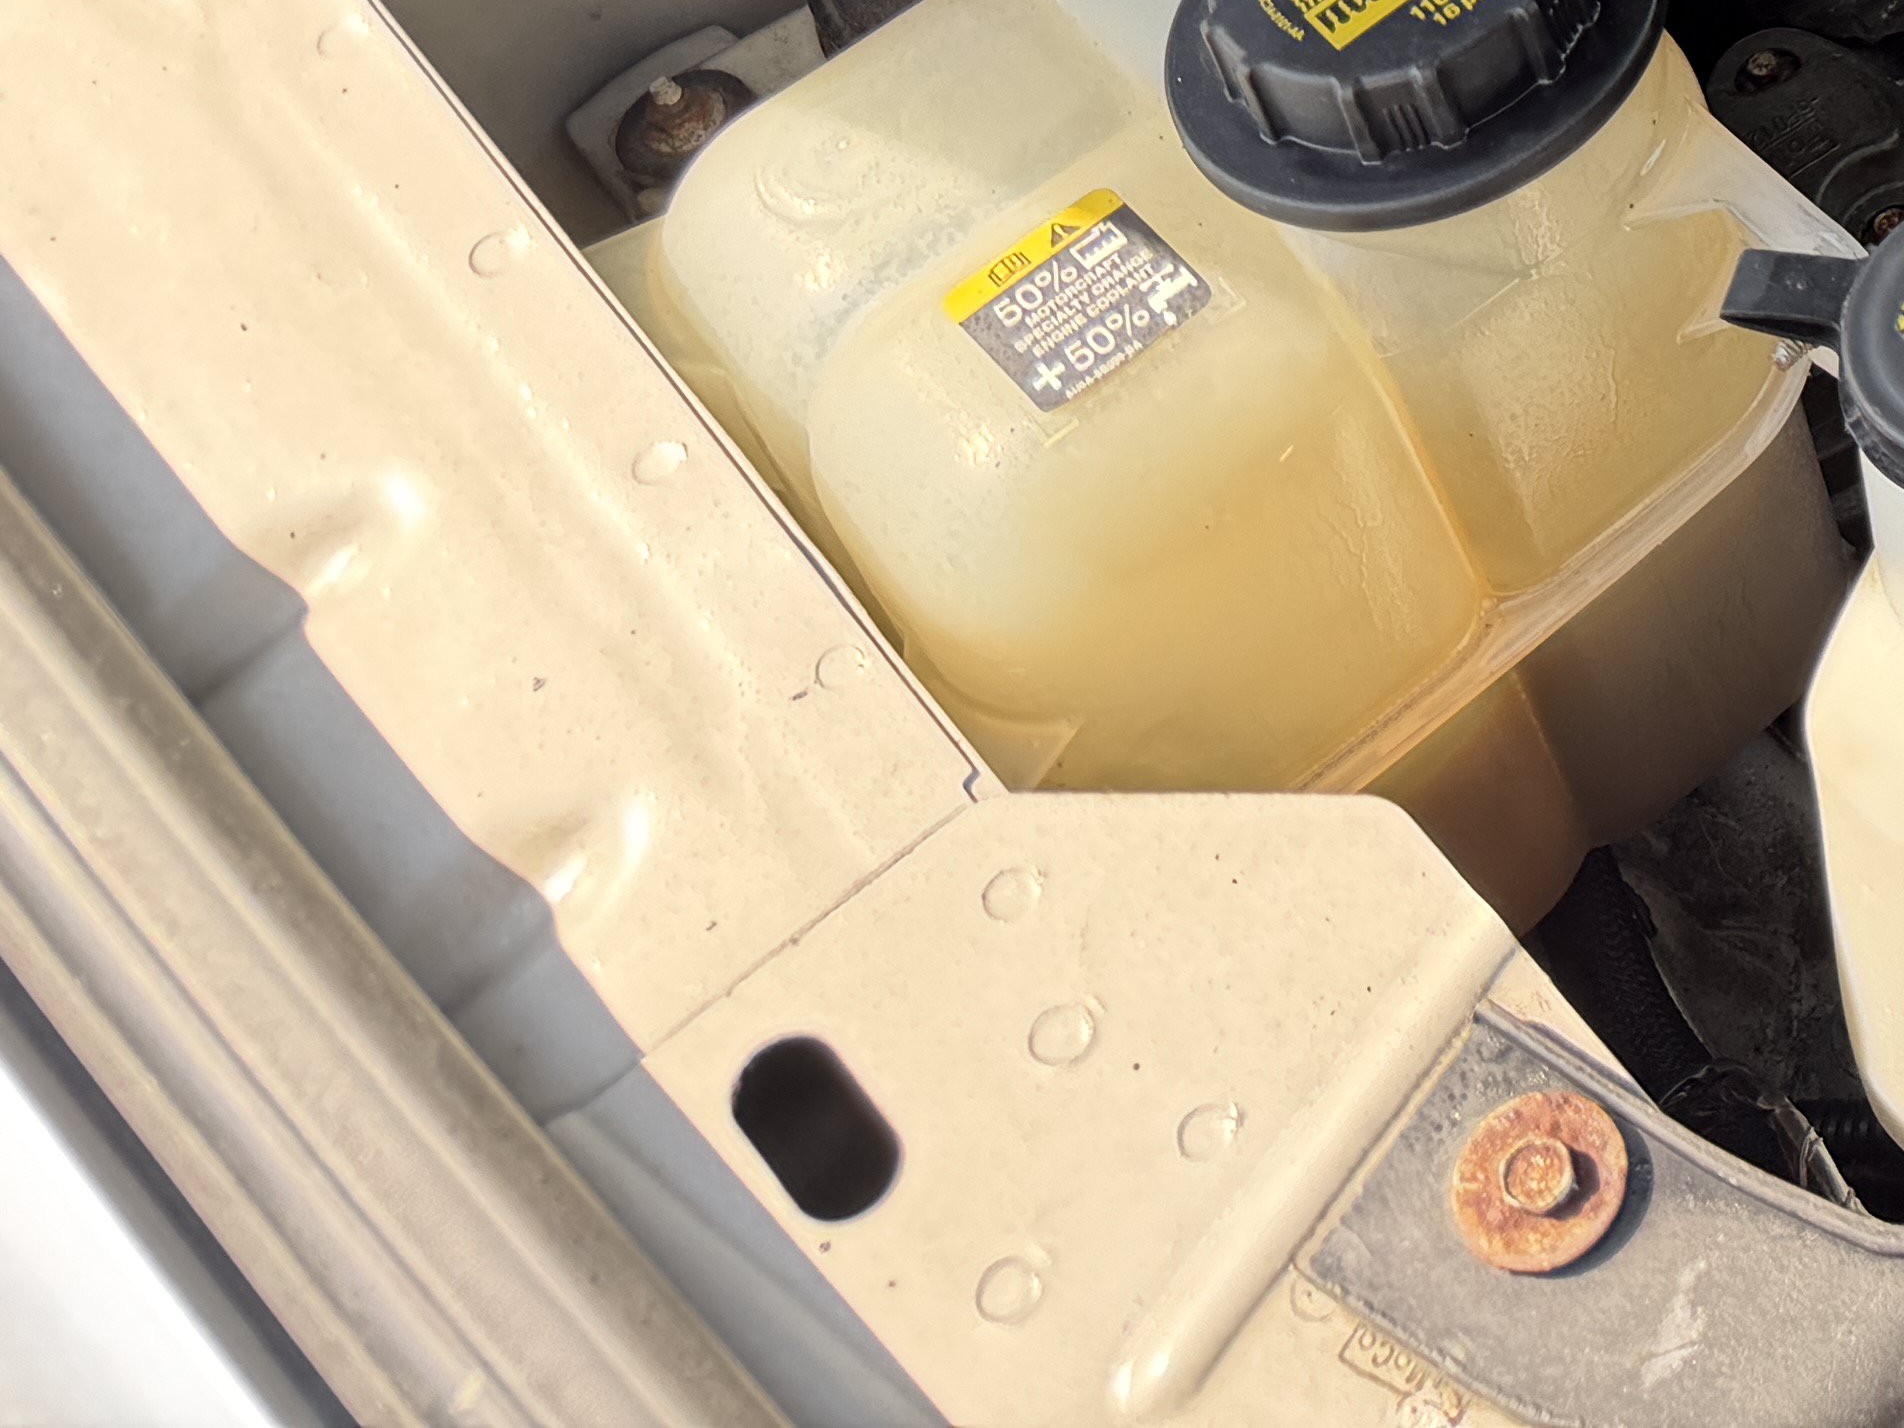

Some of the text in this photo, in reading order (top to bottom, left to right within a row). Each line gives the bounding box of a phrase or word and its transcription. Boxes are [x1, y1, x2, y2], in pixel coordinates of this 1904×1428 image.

[1432, 3, 1461, 26] 16
[987, 254, 1084, 329] 50%
[1009, 247, 1156, 354] SPECIALTY ORANGE
[1020, 253, 1126, 328] MOTORCRAFT
[1029, 262, 1159, 358] ENGINE COOLANT
[1058, 298, 1157, 373] 50%
